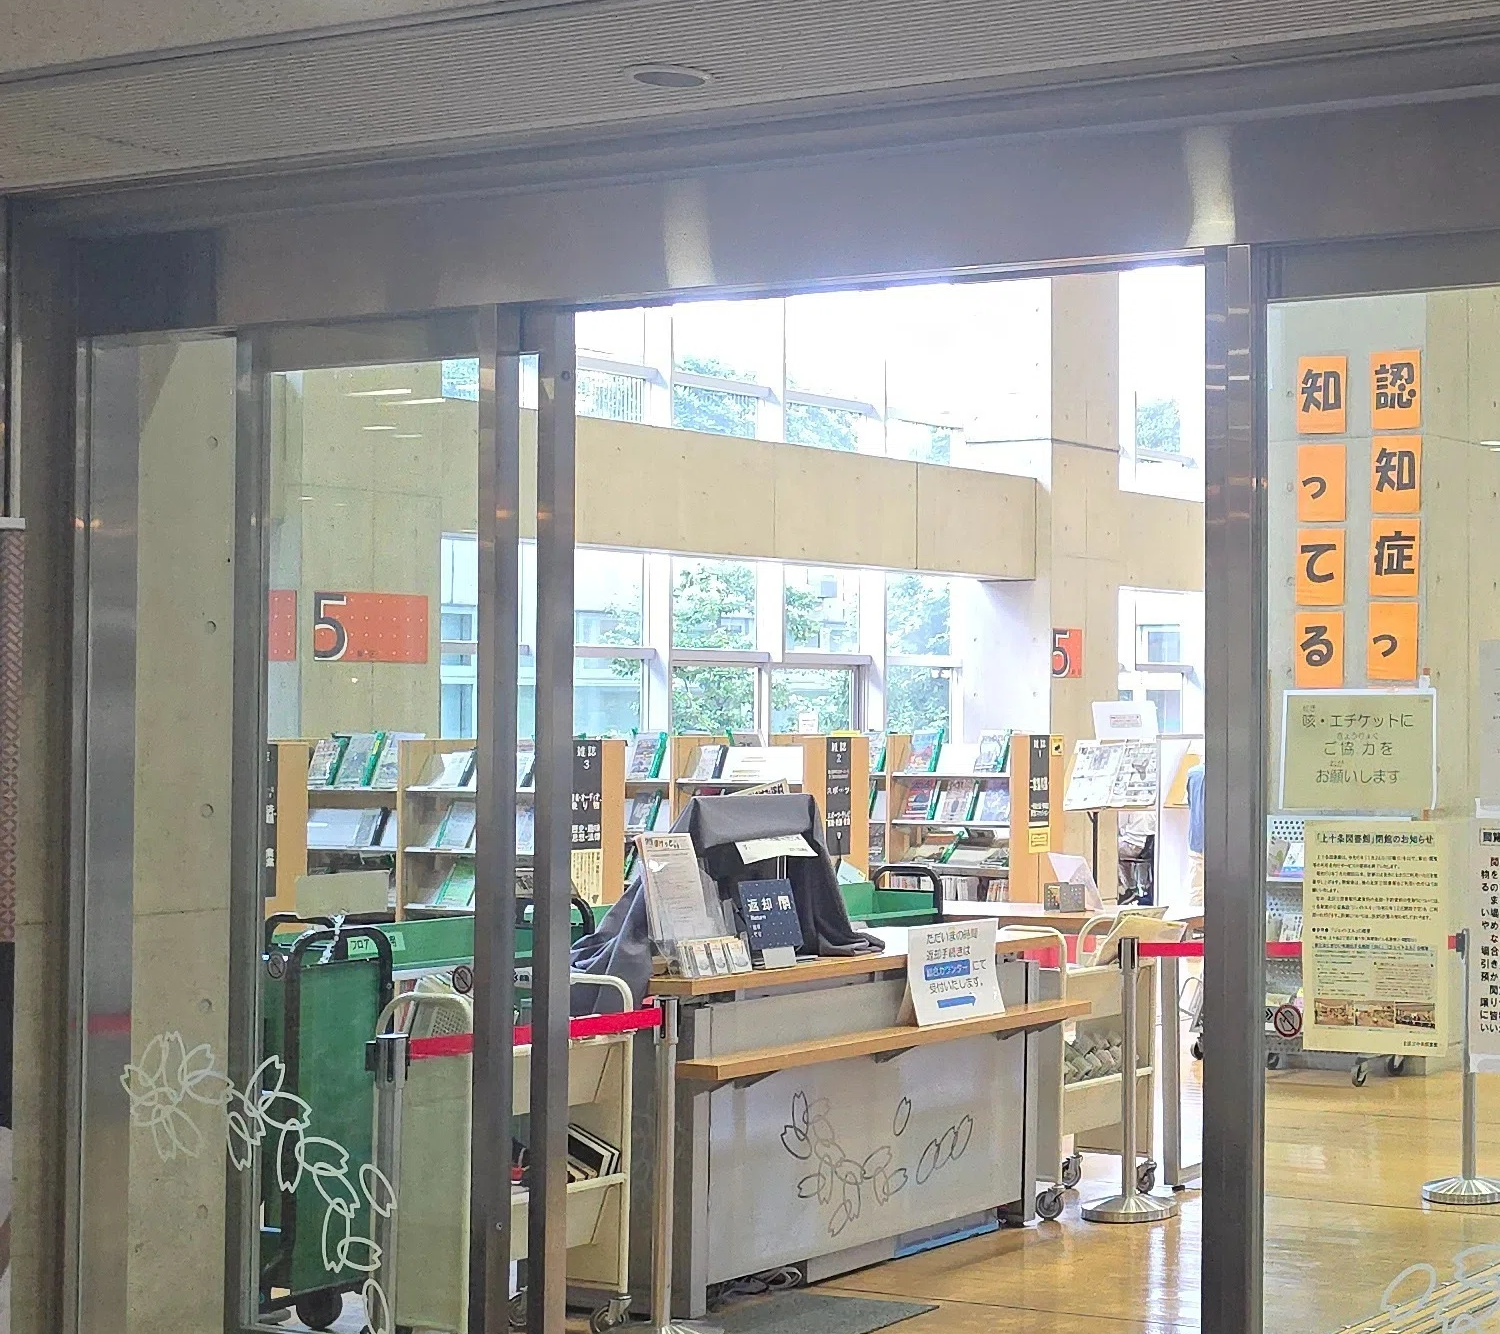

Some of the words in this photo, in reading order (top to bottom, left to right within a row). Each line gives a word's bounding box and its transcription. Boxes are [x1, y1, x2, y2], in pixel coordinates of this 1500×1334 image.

[1300, 369, 1341, 667] 知ってる
[1373, 362, 1417, 658] 認知症っ
[314, 592, 348, 661] 5
[1052, 628, 1070, 677] 5
[1302, 713, 1414, 728] 咳・エチケットに
[583, 759, 591, 770] 3
[1324, 741, 1393, 756] ご協力を
[1316, 769, 1400, 784] お願いします
